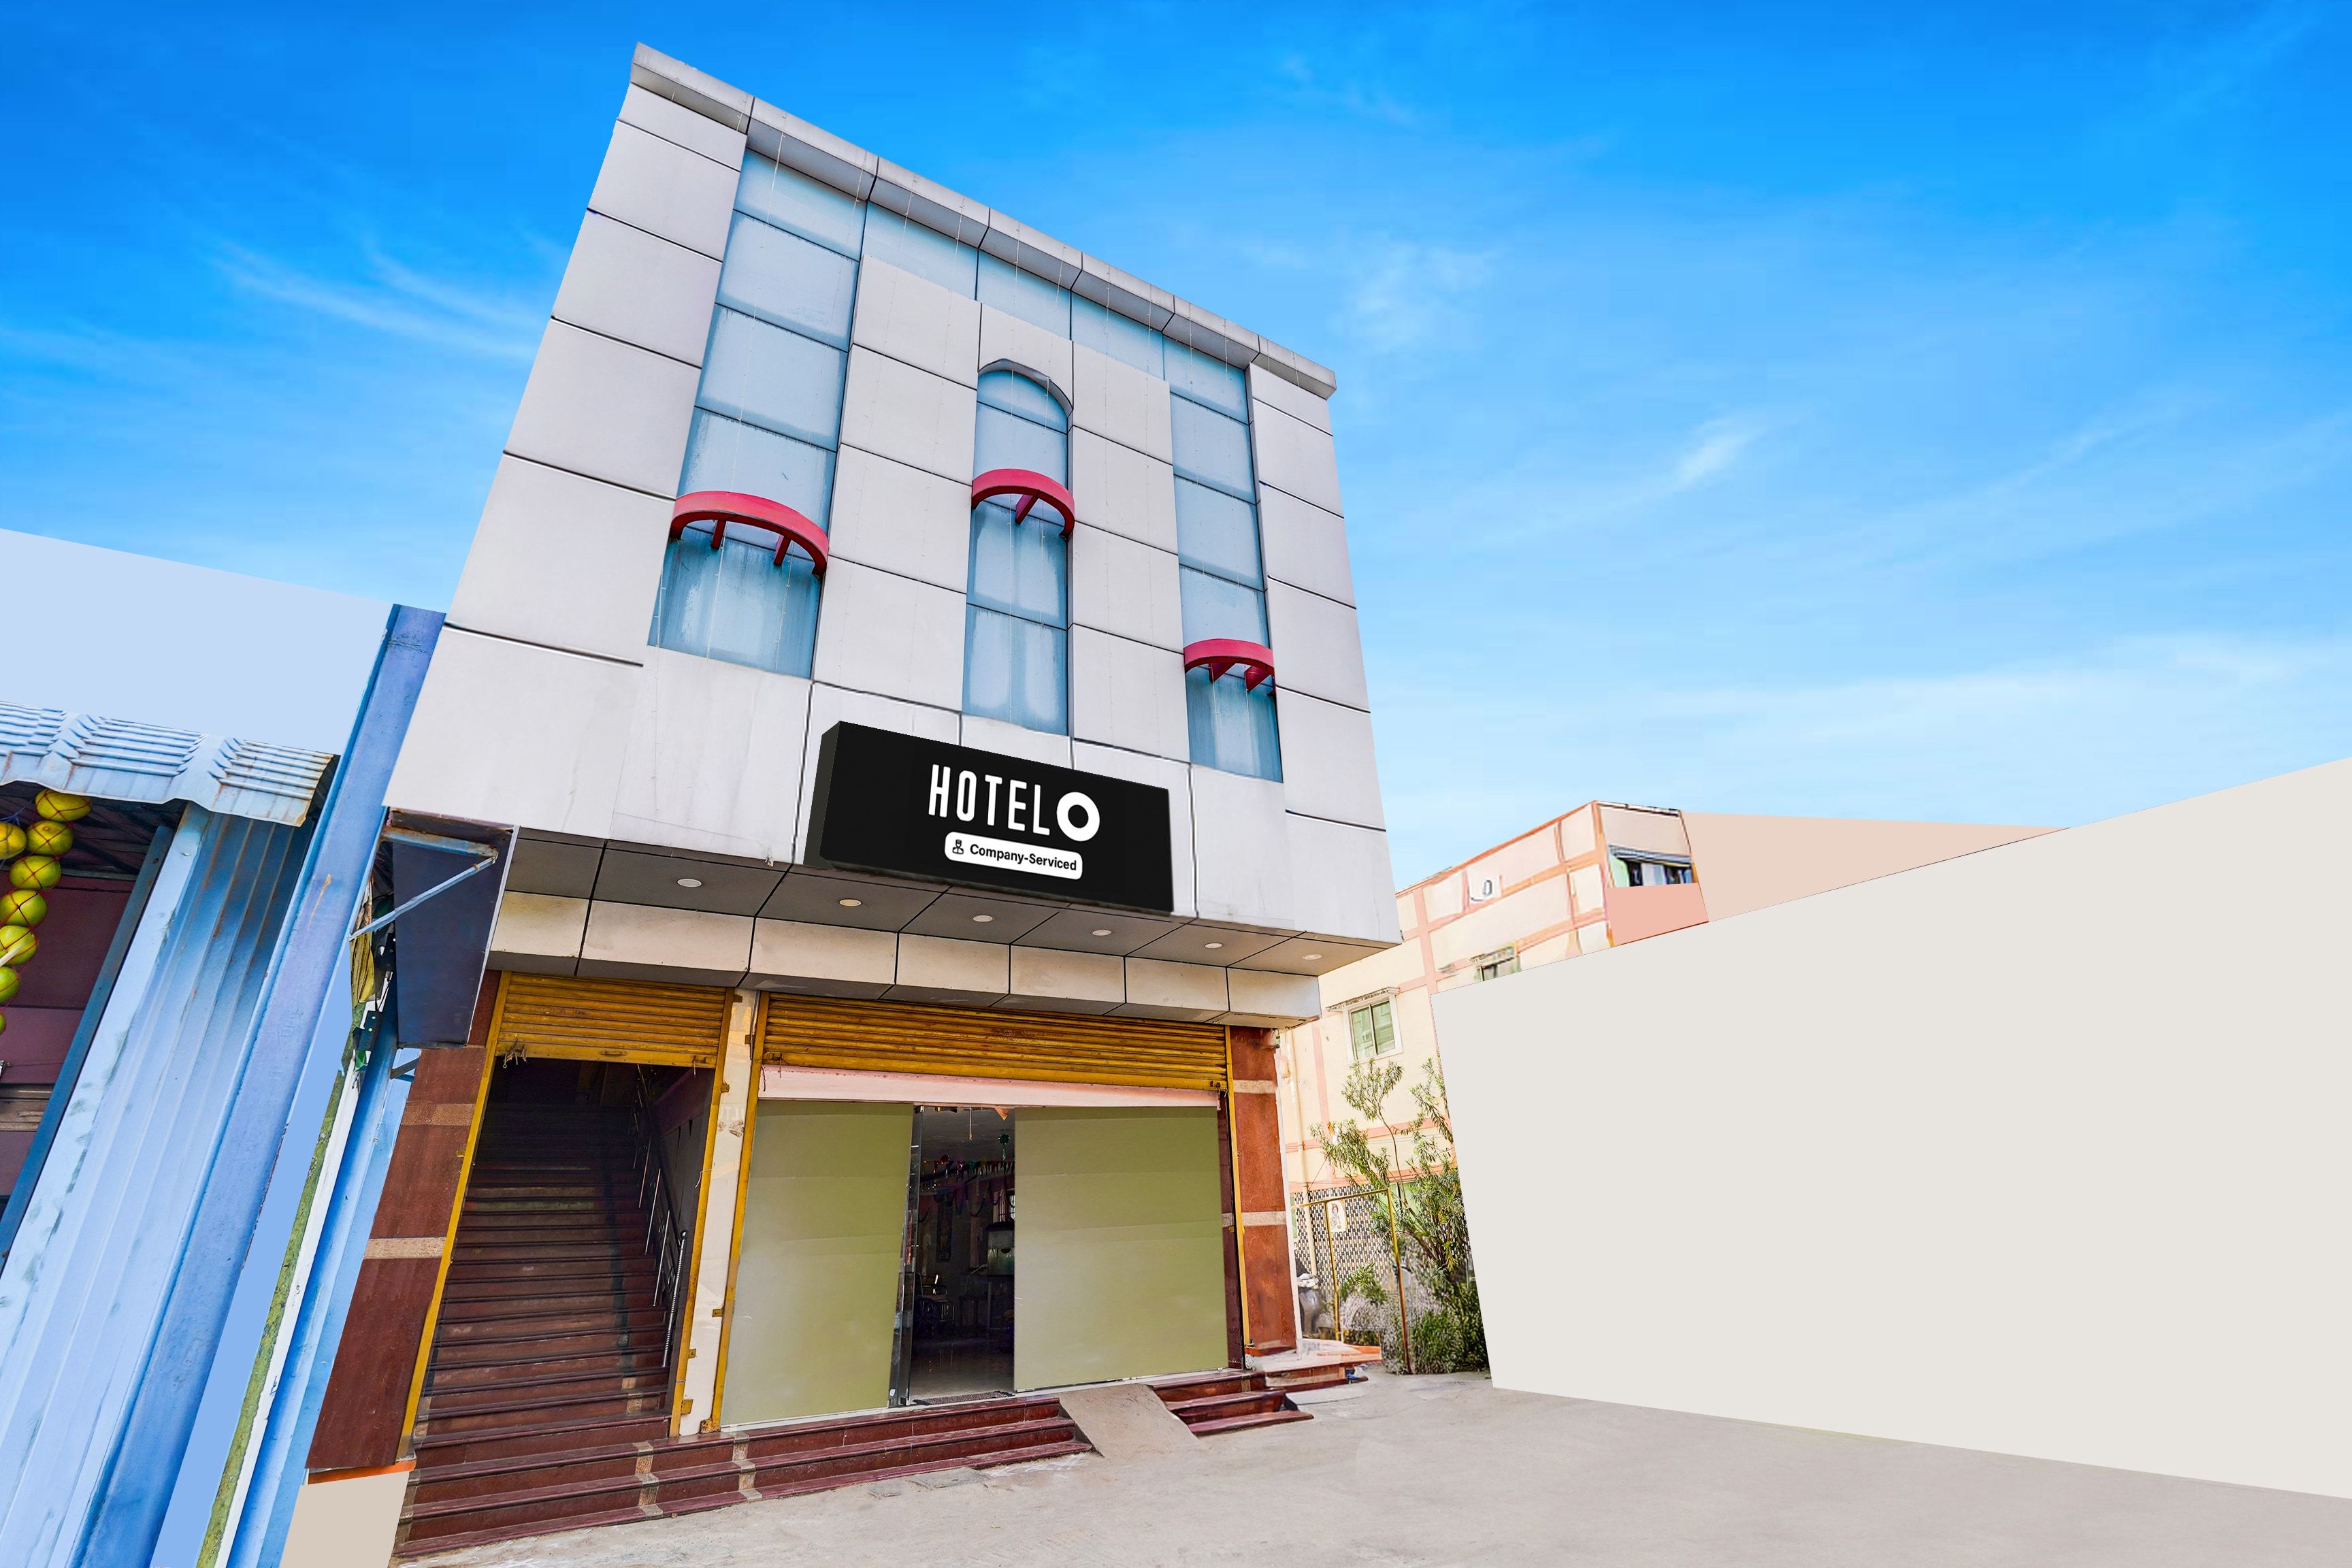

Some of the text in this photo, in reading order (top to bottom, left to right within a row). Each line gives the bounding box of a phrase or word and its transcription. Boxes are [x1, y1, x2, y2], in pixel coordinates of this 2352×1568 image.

[928, 764, 1100, 842] HOTEL O
[970, 843, 1077, 871] Company-Serviced
